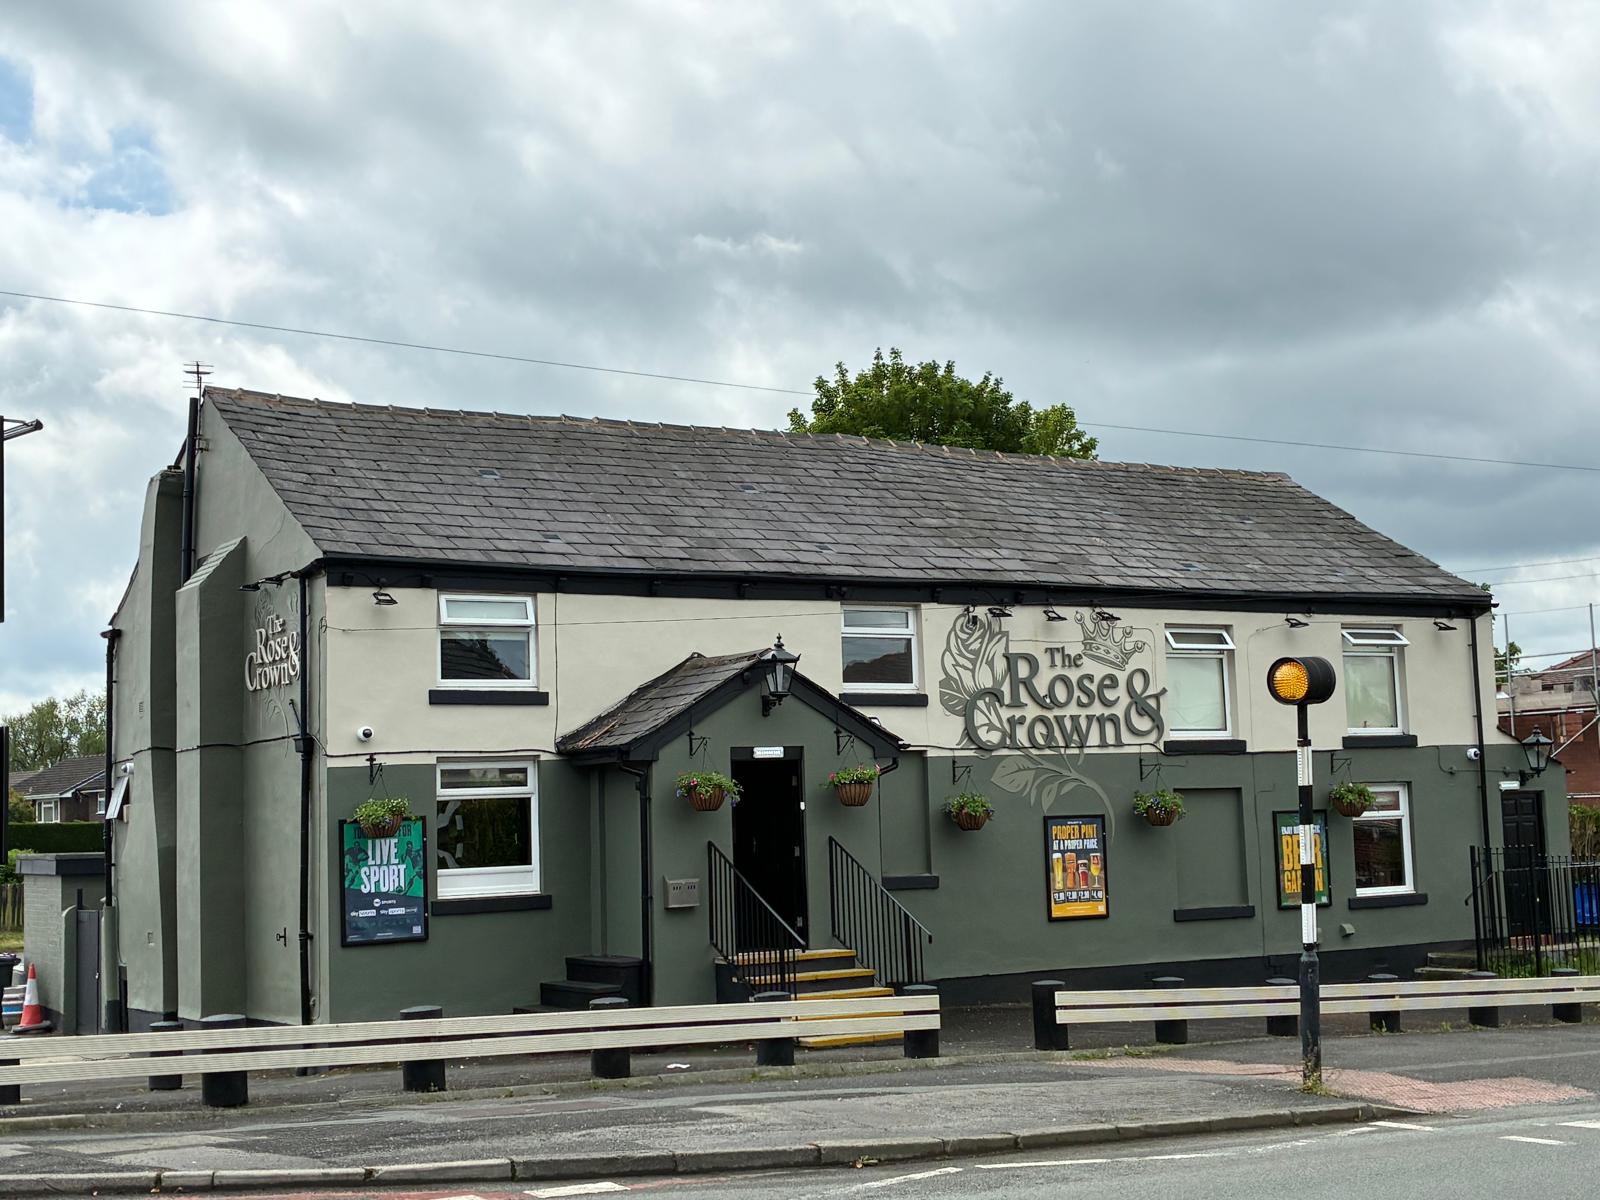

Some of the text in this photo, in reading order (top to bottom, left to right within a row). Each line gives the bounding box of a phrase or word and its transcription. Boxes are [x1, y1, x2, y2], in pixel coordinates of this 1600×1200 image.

[245, 652, 290, 692] Crown
[256, 628, 301, 680] Rose &
[1044, 646, 1084, 669] The
[1003, 652, 1168, 744] Rose &
[965, 688, 1125, 750] Crown
[1052, 824, 1097, 840] PROPER PINT
[367, 839, 399, 865] LIVE
[1282, 833, 1323, 871] BER
[360, 865, 407, 894] SPORT
